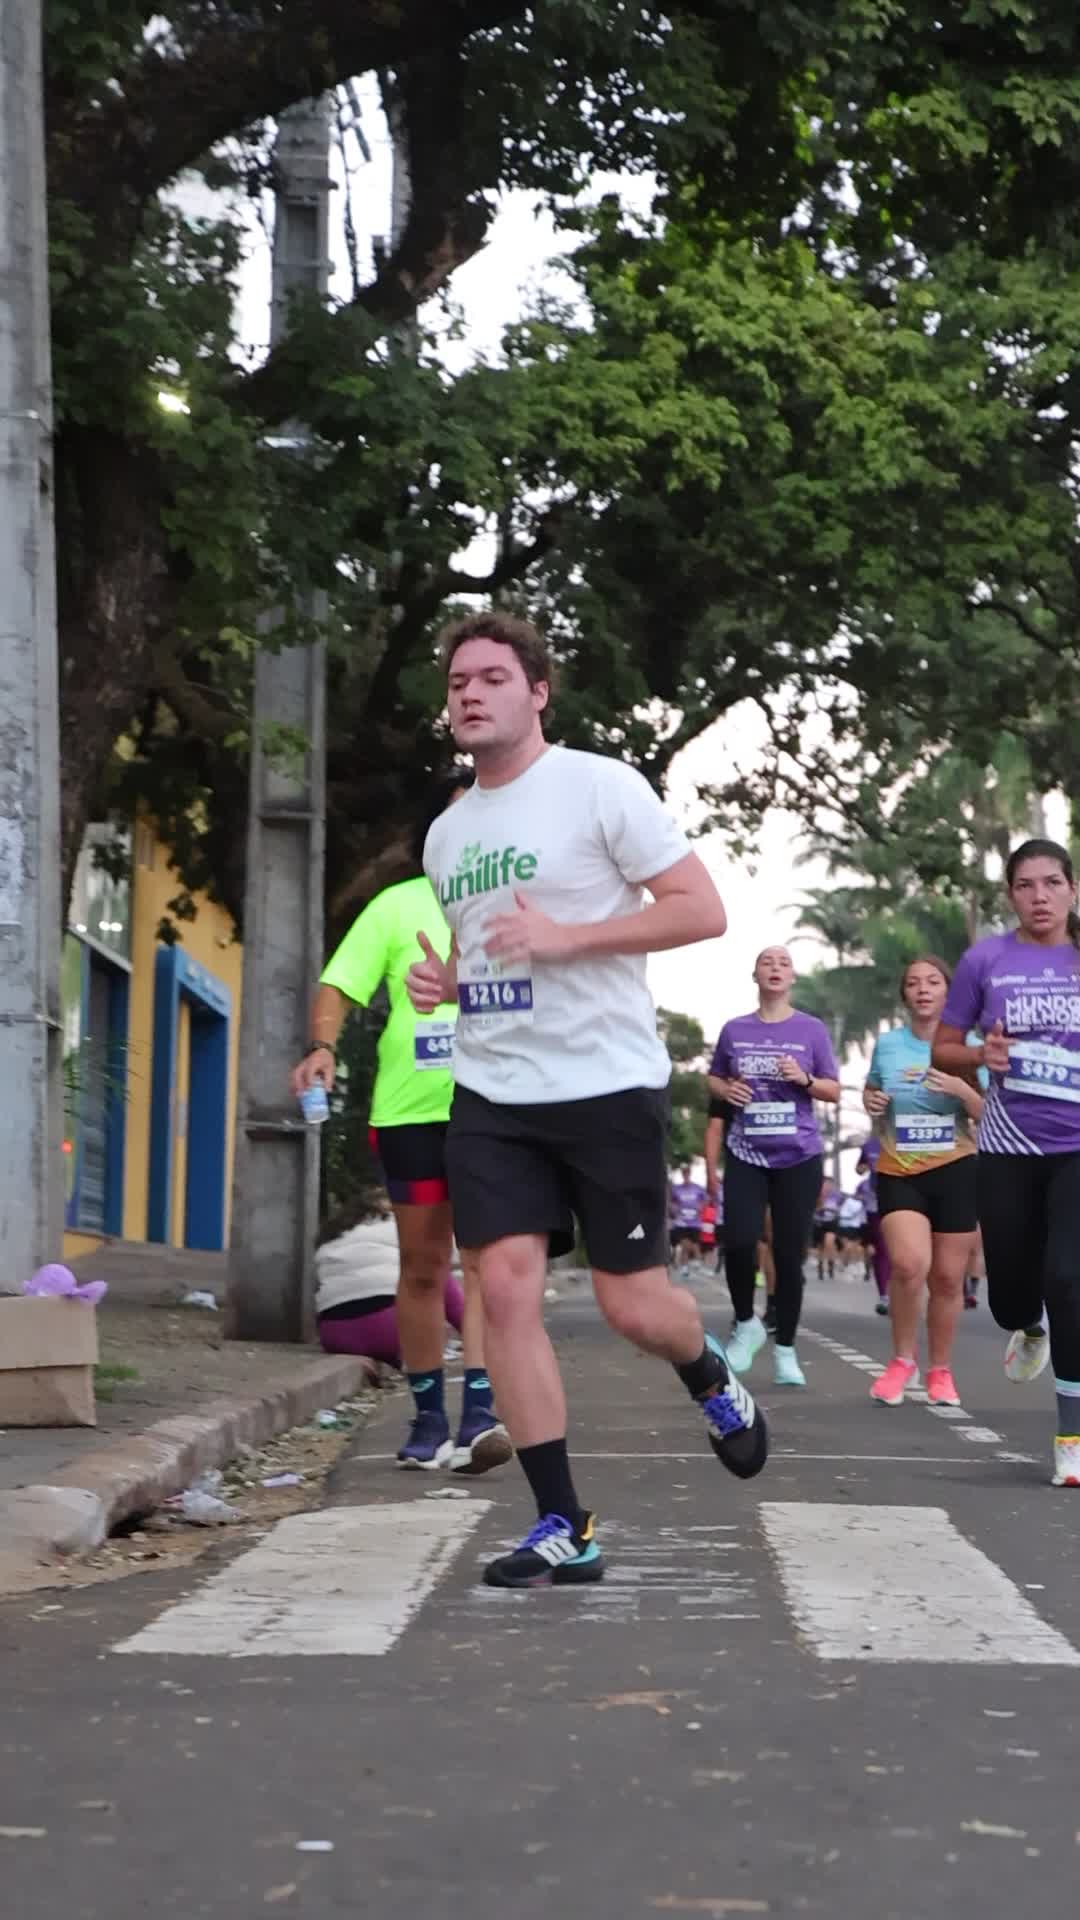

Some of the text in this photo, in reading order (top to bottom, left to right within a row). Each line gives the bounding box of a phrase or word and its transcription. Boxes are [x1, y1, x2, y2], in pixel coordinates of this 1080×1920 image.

[440, 846, 538, 907] unilife
[468, 982, 516, 1007] 5216
[907, 1127, 943, 1139] 5339
